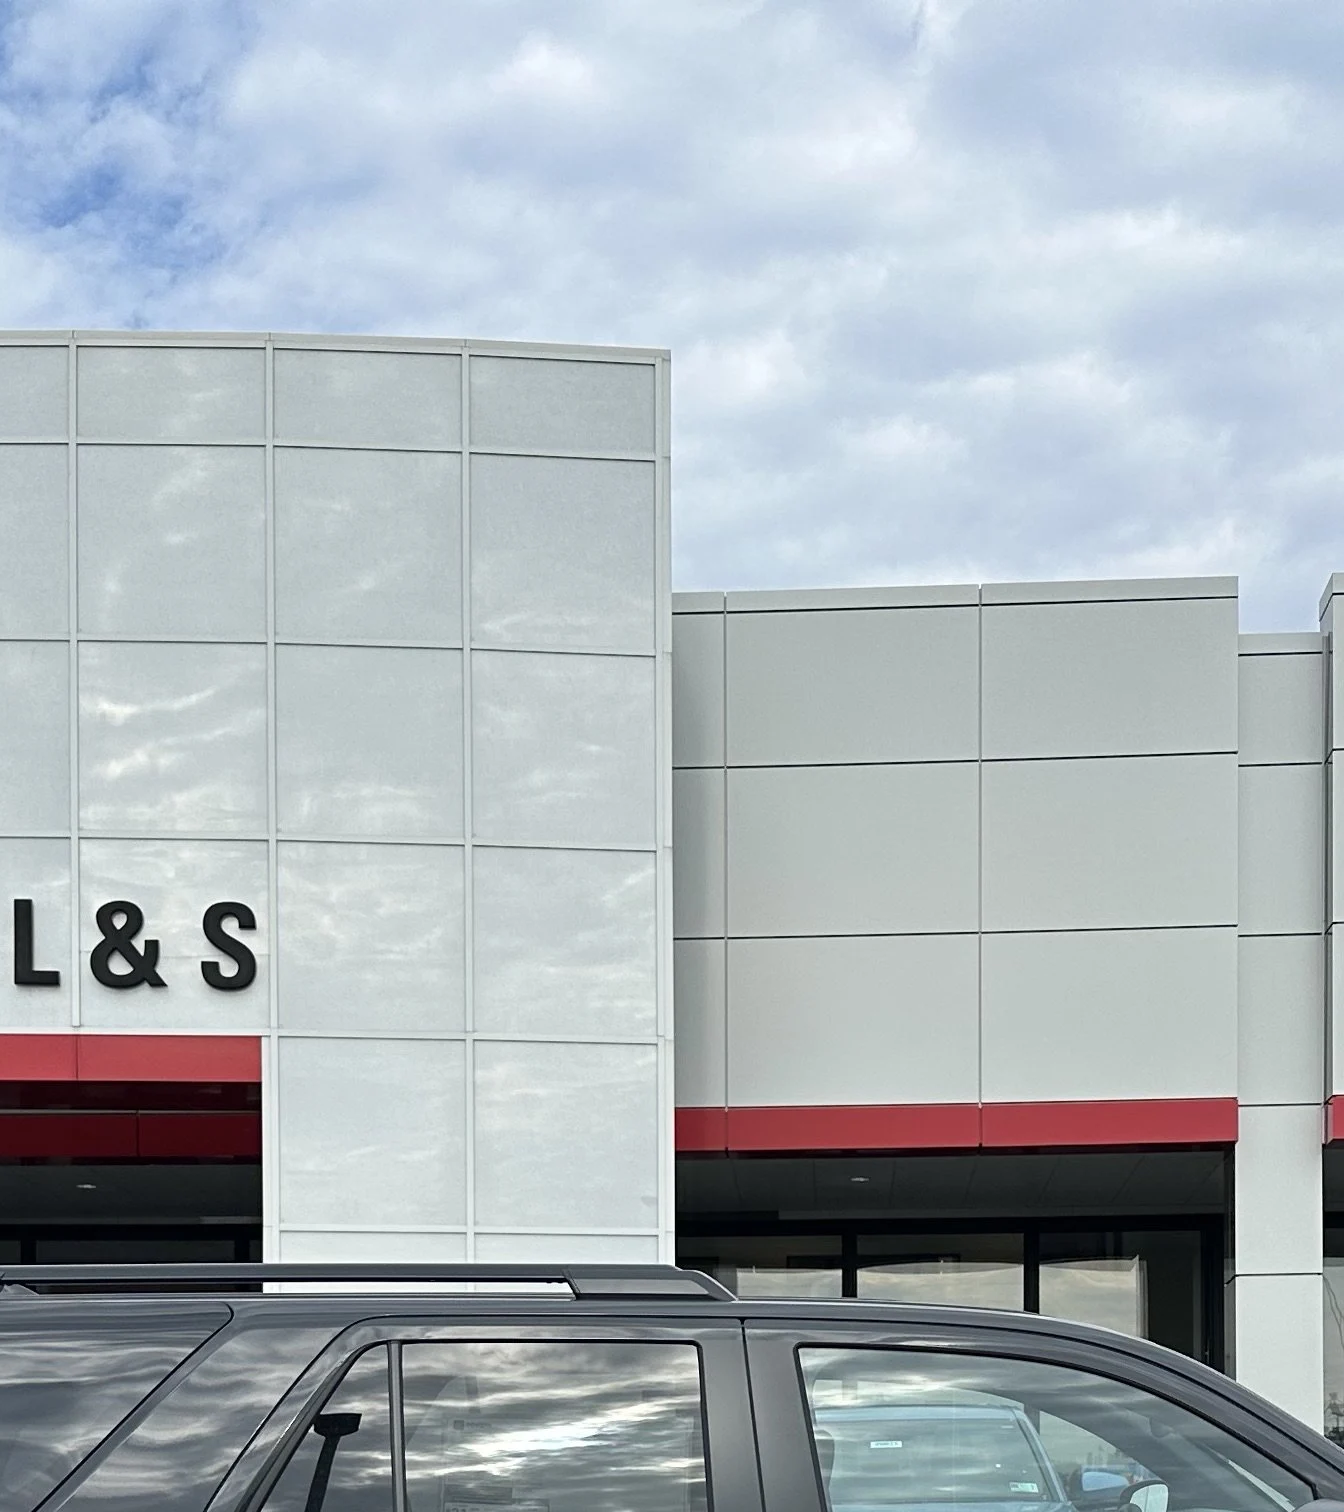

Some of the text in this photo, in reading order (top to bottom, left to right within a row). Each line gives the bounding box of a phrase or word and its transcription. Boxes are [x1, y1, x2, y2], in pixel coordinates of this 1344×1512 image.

[14, 898, 257, 992] L & S
